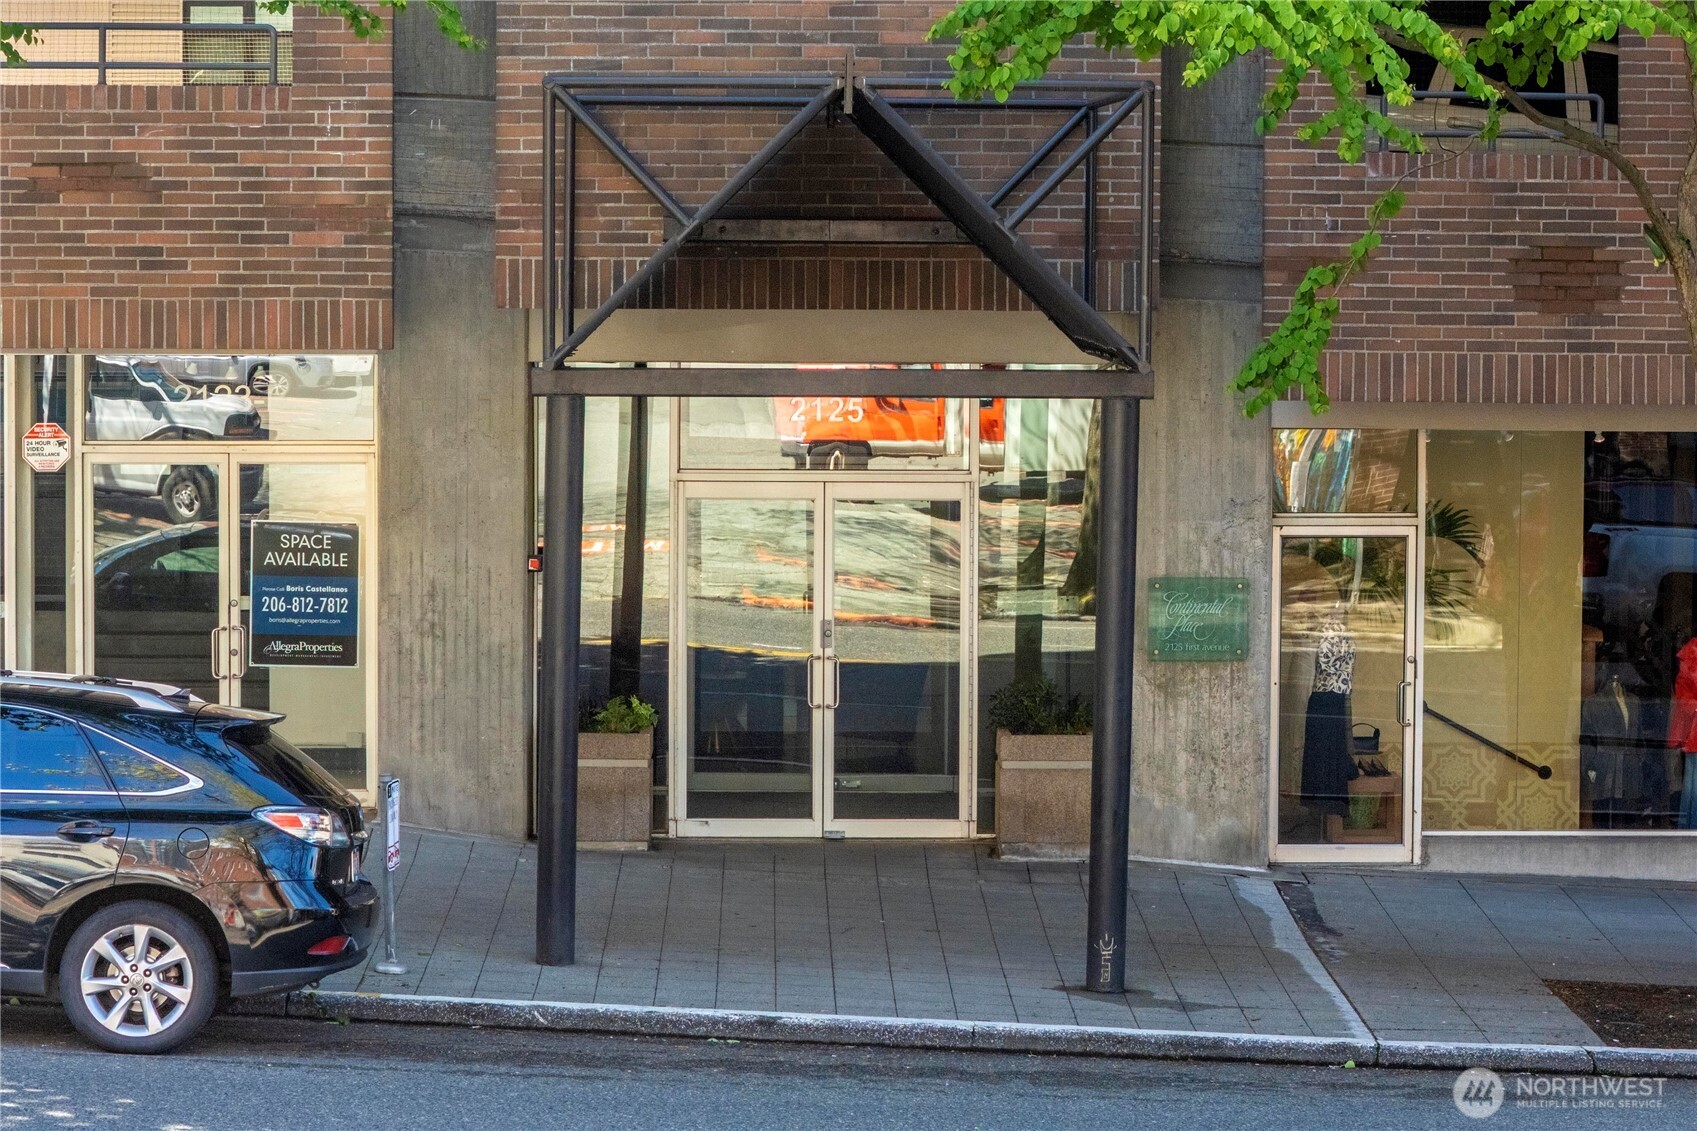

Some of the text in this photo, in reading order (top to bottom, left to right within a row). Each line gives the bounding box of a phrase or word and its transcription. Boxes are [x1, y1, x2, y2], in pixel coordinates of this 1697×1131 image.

[789, 397, 864, 422] 2125
[280, 534, 332, 549] SPACE
[263, 551, 348, 567] AVAILABLE
[286, 584, 304, 592] Boris
[305, 585, 348, 593] Castellanos
[262, 596, 348, 613] 206-812-7812
[1163, 590, 1234, 619] Continental
[1157, 613, 1217, 641] Place
[1164, 643, 1183, 651] 2125
[1185, 642, 1200, 651] first
